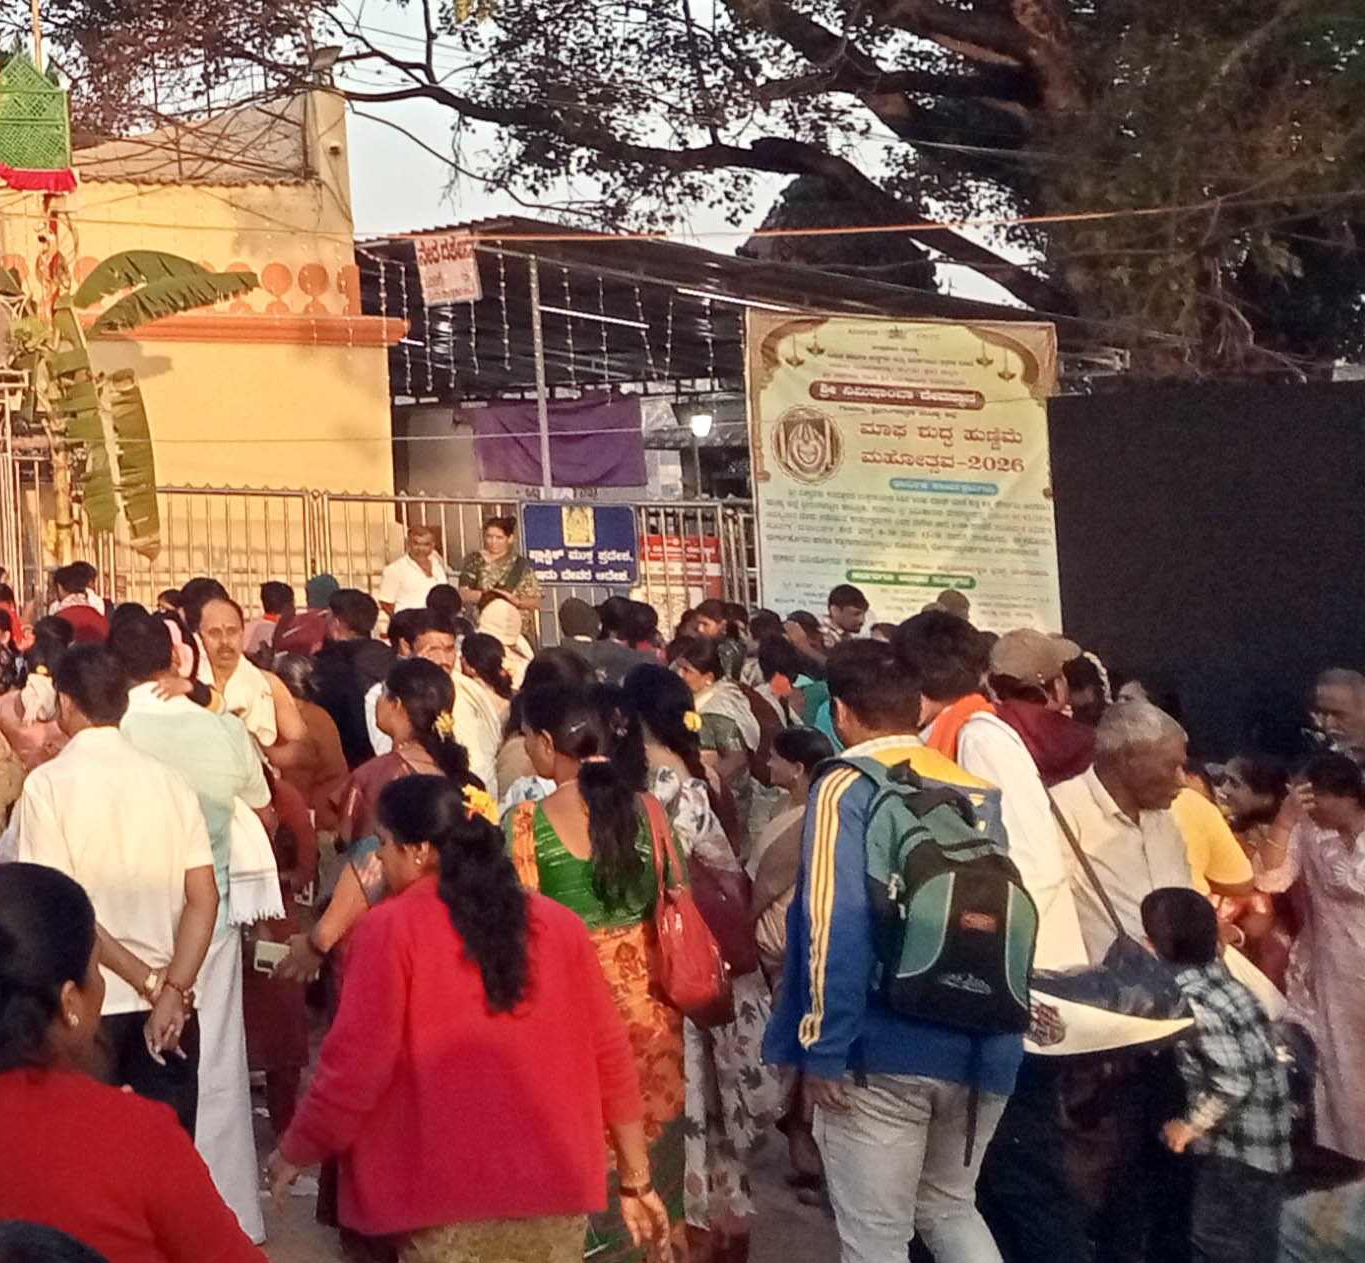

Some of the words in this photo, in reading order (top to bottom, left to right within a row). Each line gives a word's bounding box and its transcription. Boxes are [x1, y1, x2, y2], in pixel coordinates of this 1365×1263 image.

[819, 382, 837, 399] ಶ್ರೀ
[859, 421, 907, 440] ಮಾಘ
[962, 427, 1023, 451] ಹುಣ್ಣಿಮೆ
